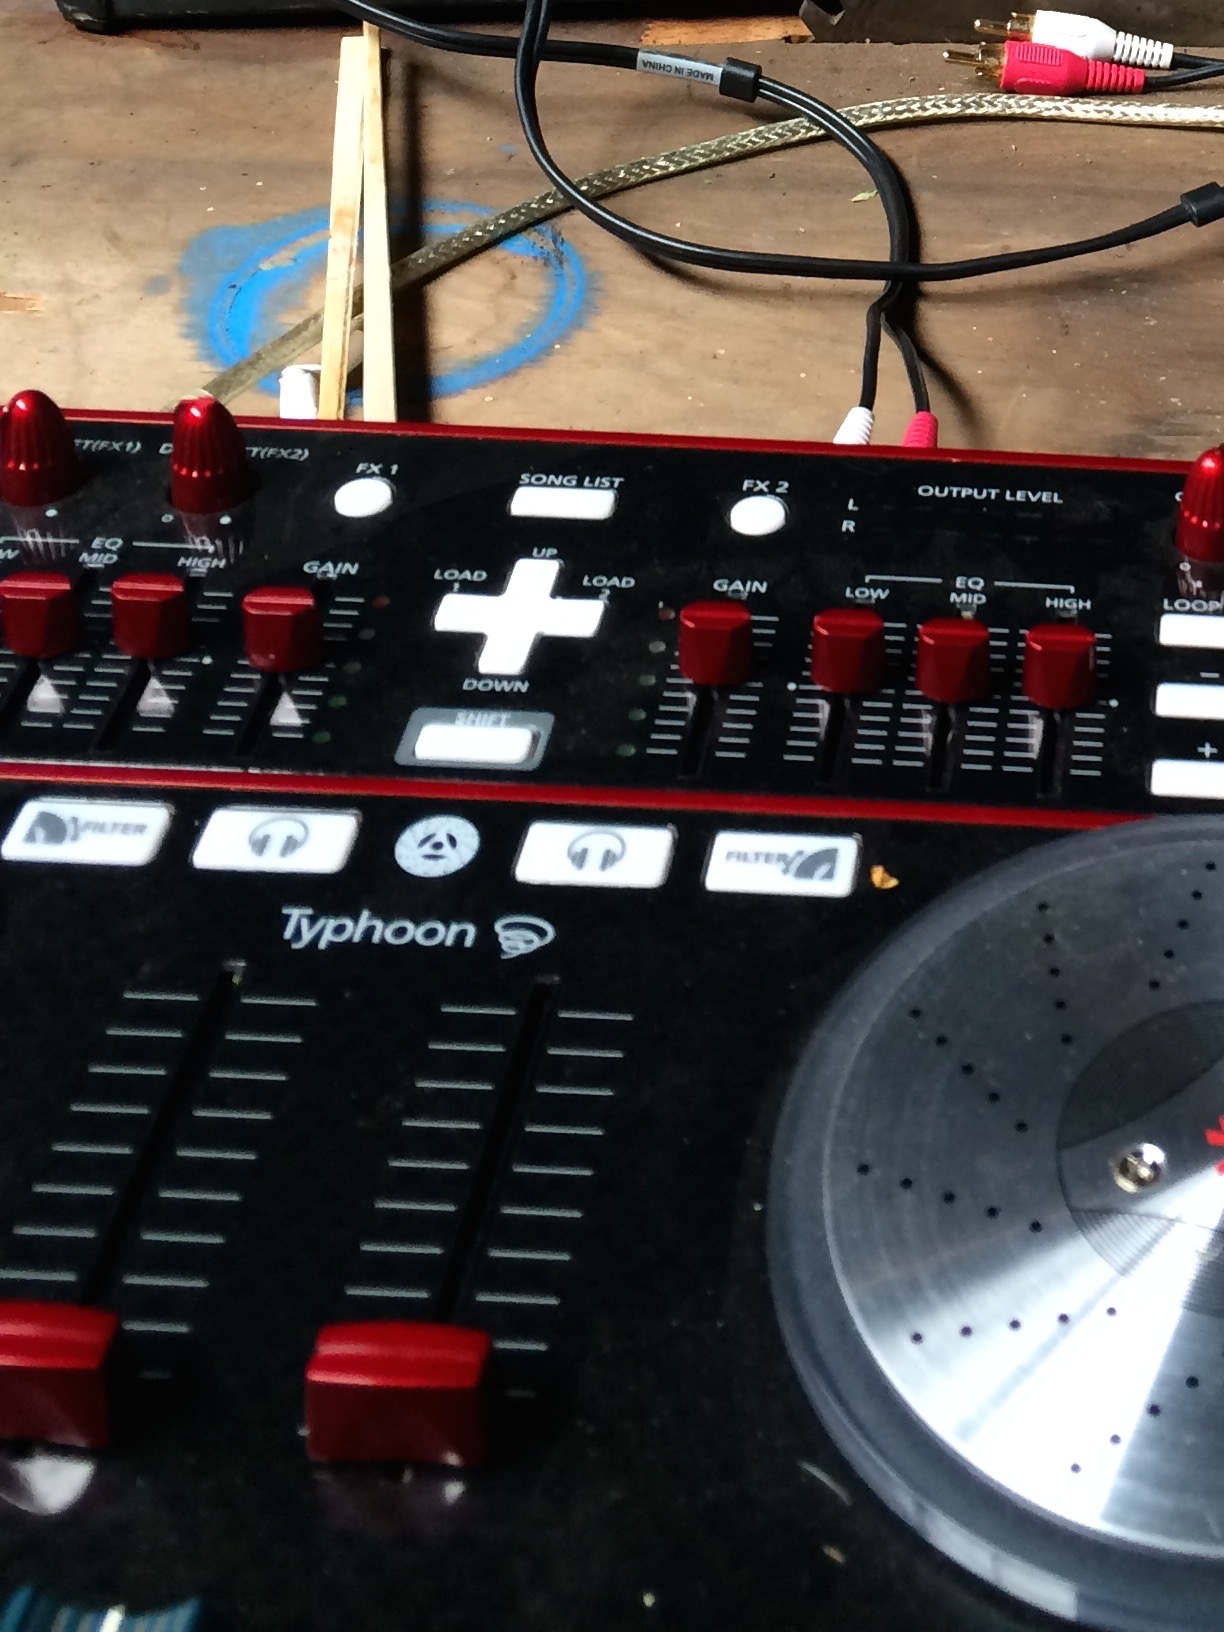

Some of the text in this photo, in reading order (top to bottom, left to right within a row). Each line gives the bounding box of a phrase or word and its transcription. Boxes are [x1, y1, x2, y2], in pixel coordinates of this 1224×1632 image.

[642, 60, 714, 81] MADE IN CHINA
[356, 463, 399, 475] FX 1
[519, 473, 624, 488] SONG LIST
[742, 480, 790, 494] FX 2
[917, 485, 1064, 505] OUTPUT LEVEL
[848, 498, 859, 511] L
[841, 520, 856, 533] R
[91, 537, 123, 549] EQ
[79, 552, 119, 564] MID
[532, 547, 558, 558] UP
[177, 557, 226, 569] HIGH
[303, 560, 359, 575] GAIN
[434, 569, 488, 582] LOAD
[583, 575, 635, 588] LOAD
[713, 579, 768, 594] GAIN
[955, 577, 984, 590] EQ
[845, 587, 890, 600] LOW
[949, 592, 986, 606] MID
[1045, 597, 1091, 611] HIGH
[1163, 598, 1224, 614] LOOP
[462, 678, 529, 693] DOWN
[281, 906, 477, 950] Typhoon
